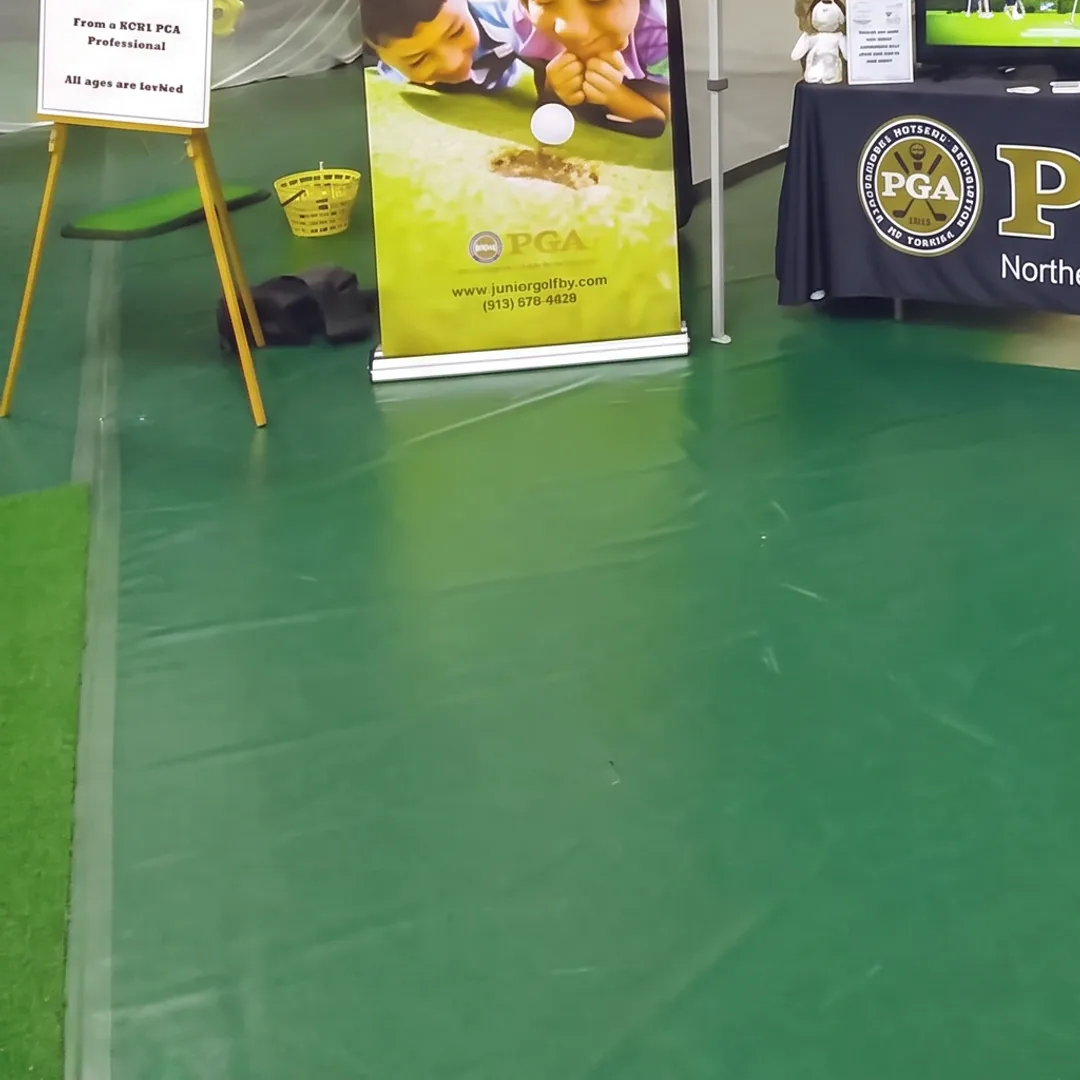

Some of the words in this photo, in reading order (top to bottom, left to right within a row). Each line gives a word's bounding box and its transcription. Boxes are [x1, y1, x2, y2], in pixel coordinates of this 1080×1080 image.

[73, 17, 106, 29] From
[88, 36, 166, 51] Professional
[64, 75, 82, 85] All
[84, 78, 113, 89] ages
[116, 81, 136, 90] are
[881, 171, 960, 201] PGA
[507, 229, 590, 256] PGA
[483, 298, 515, 313] (913)
